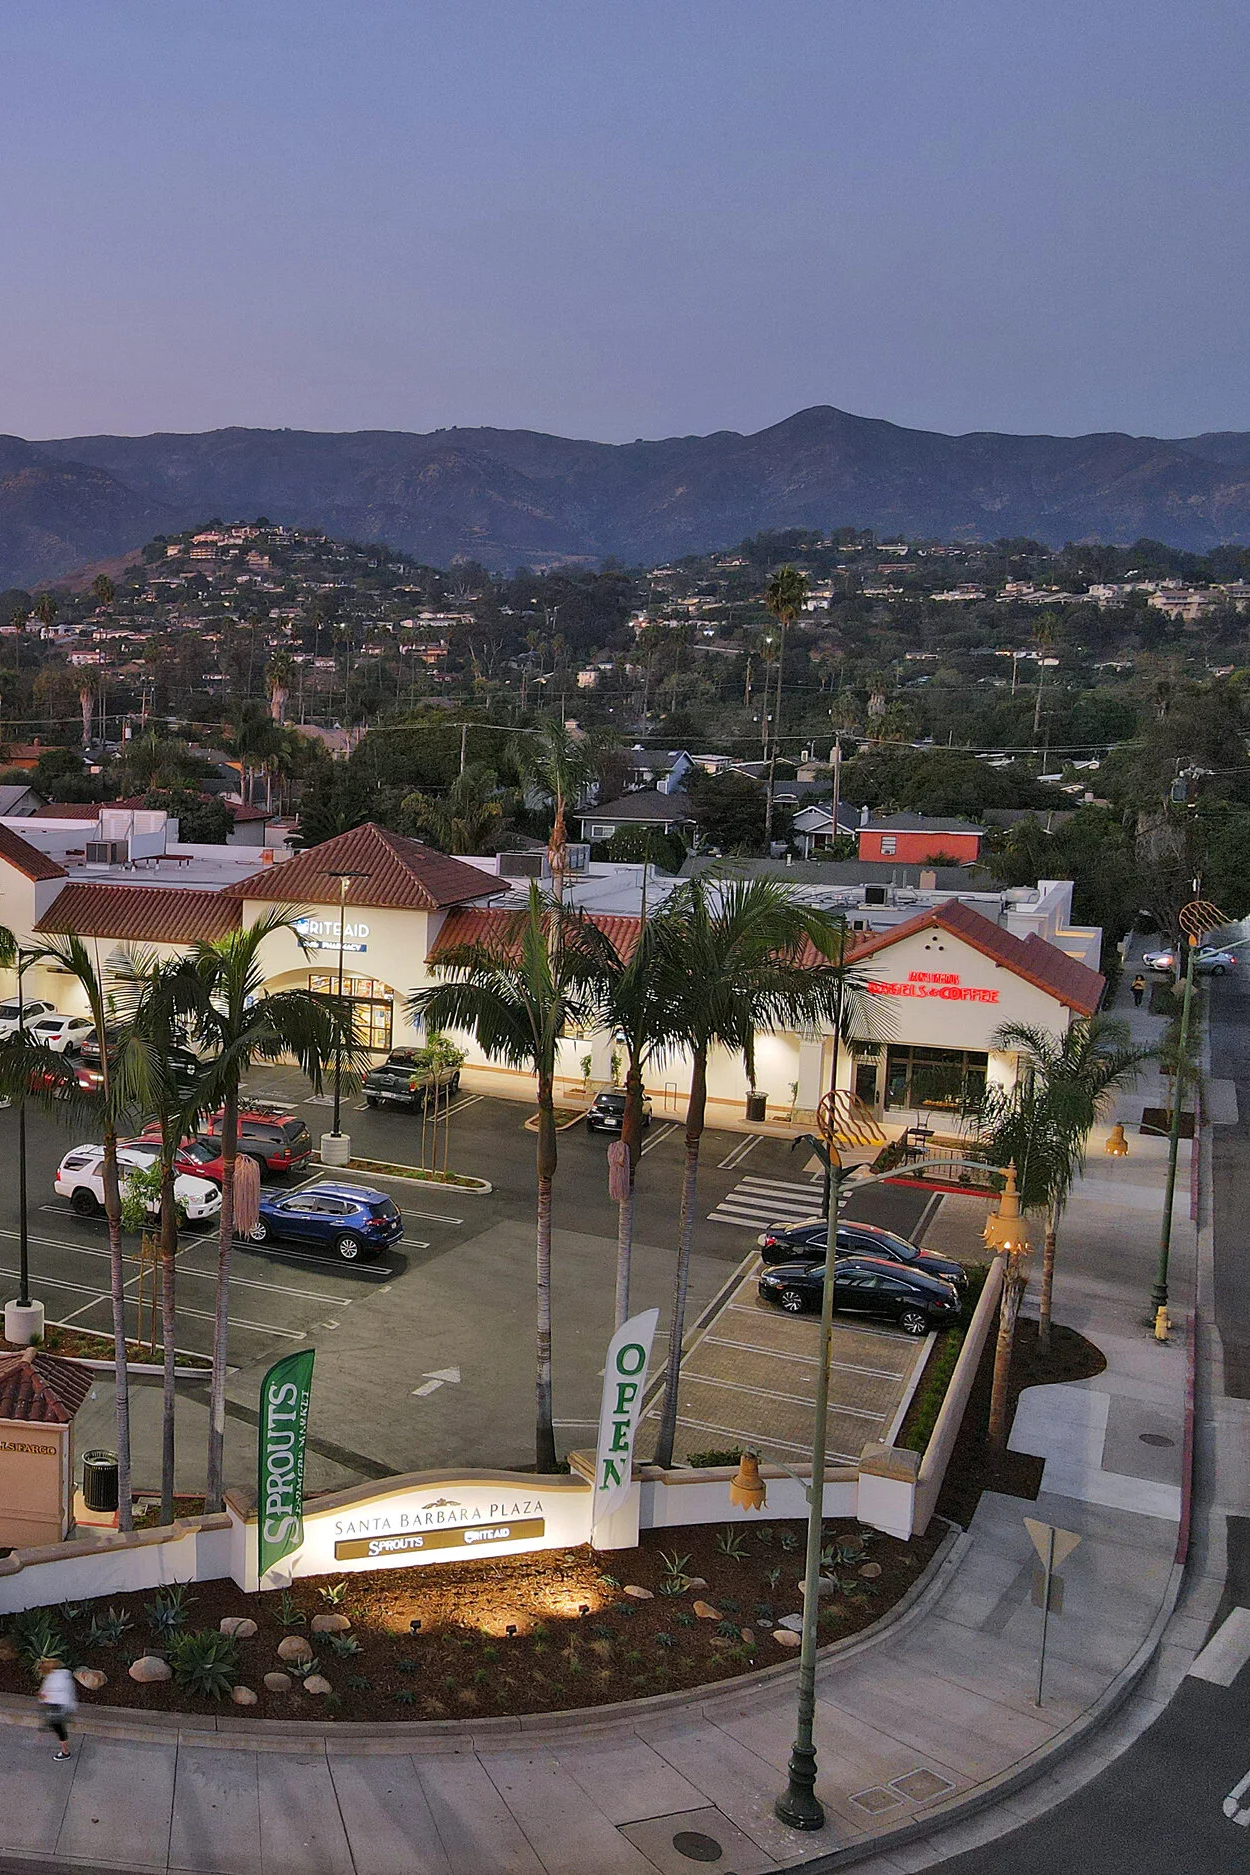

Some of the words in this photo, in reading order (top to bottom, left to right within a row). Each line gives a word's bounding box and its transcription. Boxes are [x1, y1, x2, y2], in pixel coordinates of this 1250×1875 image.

[309, 920, 342, 936] RITE
[343, 923, 370, 938] AID
[939, 986, 1000, 1004] COFFEE
[598, 1343, 647, 1491] OPEN
[16, 1442, 57, 1456] FARGO
[263, 1382, 300, 1544] SPROUTS
[334, 1517, 392, 1536] SANTA
[400, 1507, 482, 1528] BARBARA
[489, 1500, 544, 1518] PLAZA
[368, 1536, 424, 1556] SPROUTS
